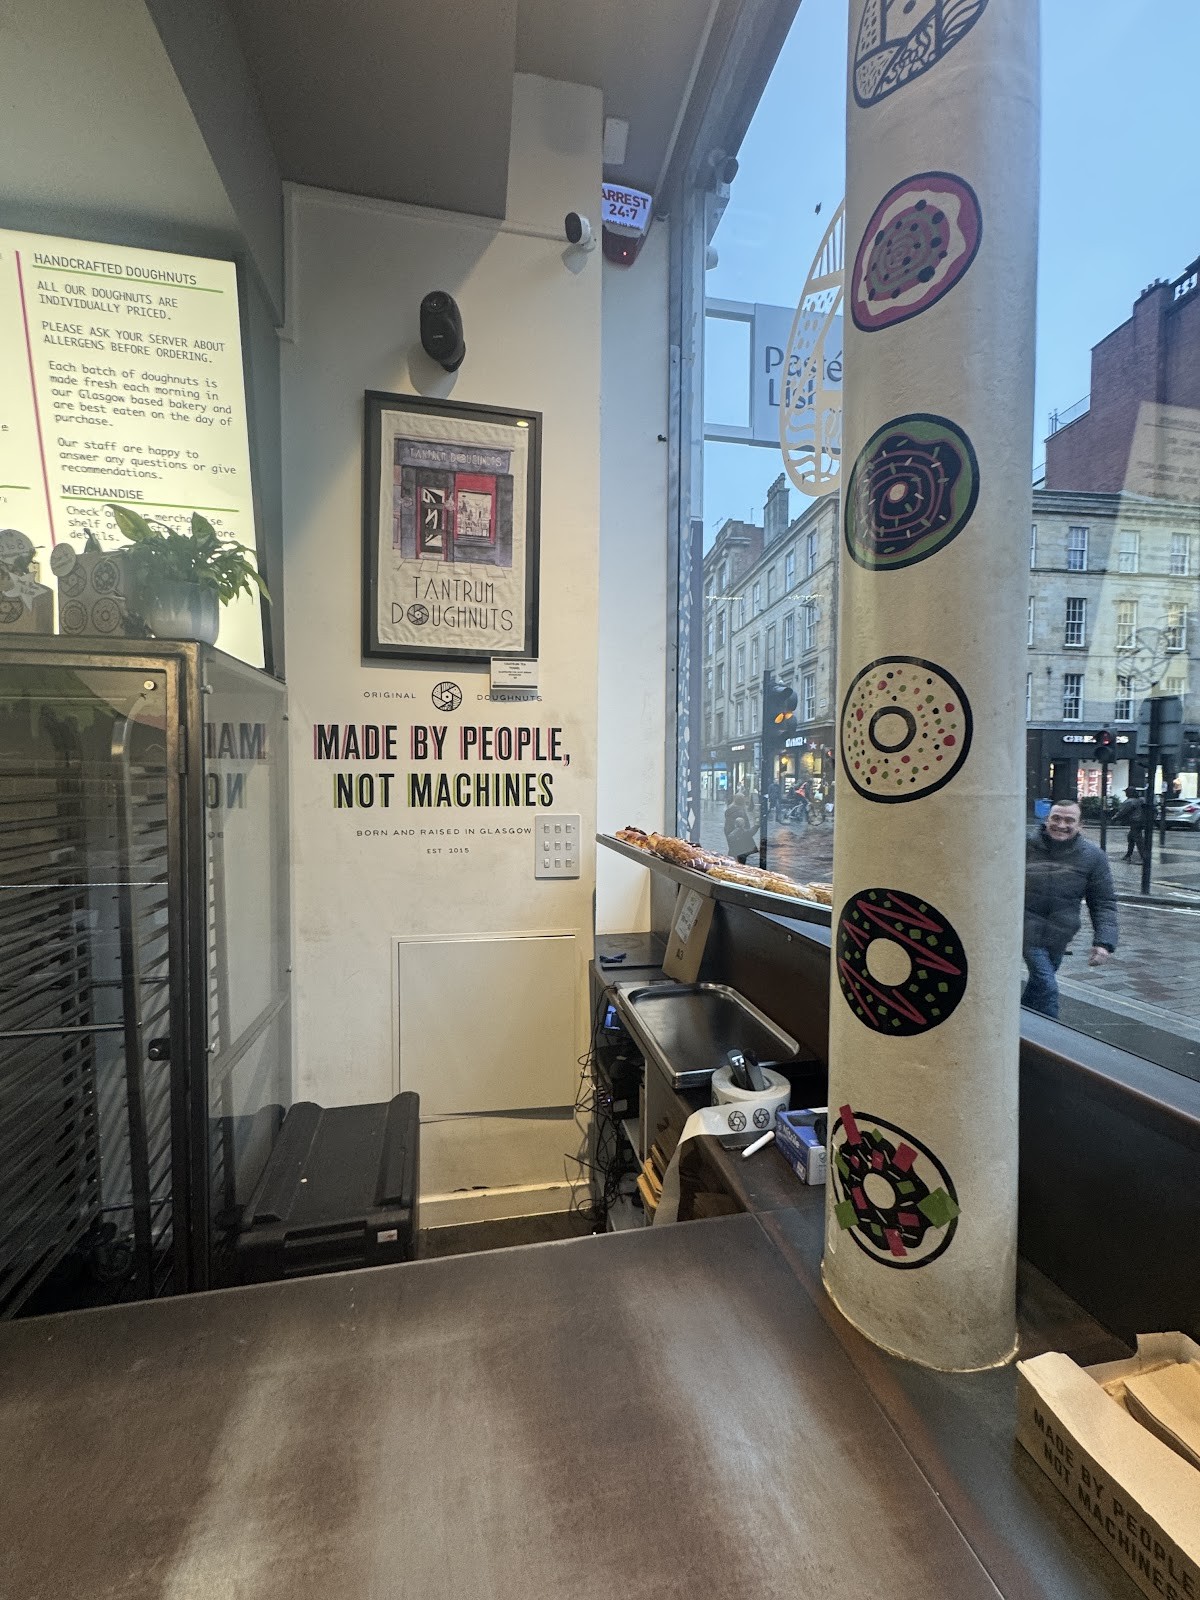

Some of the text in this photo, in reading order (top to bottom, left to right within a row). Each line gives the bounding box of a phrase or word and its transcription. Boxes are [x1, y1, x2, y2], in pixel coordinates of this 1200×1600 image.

[609, 203, 638, 220] 24:7
[34, 253, 197, 285] HANDCRAFTED DOUGHNUTS
[37, 280, 178, 308] ALL OUR DOUGHNUTS ARE
[39, 293, 171, 320] INDIVIDUALLY PRICED.
[42, 320, 225, 352] PLEASE ASK YOUR SERVER ABOUT
[44, 334, 213, 363] ALLERGENS BEFORE ORDERING.
[48, 360, 218, 389] Each batch of doughnuts is
[49, 375, 219, 401] made fresh each morning in
[51, 388, 232, 414] our Glasgow based bakery and
[53, 401, 233, 426] are best eaten on the day of
[54, 414, 114, 427] purchase.
[57, 437, 199, 459] Our staff are happy to
[59, 452, 237, 475] answer any questions or give
[61, 464, 163, 480] recommendations.
[61, 485, 144, 500] MERCHANDISE
[66, 505, 100, 517] Check
[155, 513, 223, 526] merchase
[68, 518, 101, 528] shelf
[215, 530, 236, 538] ore
[69, 530, 120, 542] deils.
[412, 575, 495, 604] TANTRUM
[391, 602, 514, 632] DOUGHNUTS
[363, 691, 543, 702] ORIGINAL DOUGHNUTS
[313, 723, 571, 767] MADE BY PEOPLE,
[333, 772, 554, 809] NOT MACHINES
[356, 829, 389, 837] BORN
[393, 828, 416, 836] AND
[420, 828, 460, 836] RAISED
[479, 827, 532, 835] GLASGOW
[1033, 1407, 1196, 1600] MADE BY PEOPLE
[1043, 1442, 1179, 1600] NOT MACHINES
